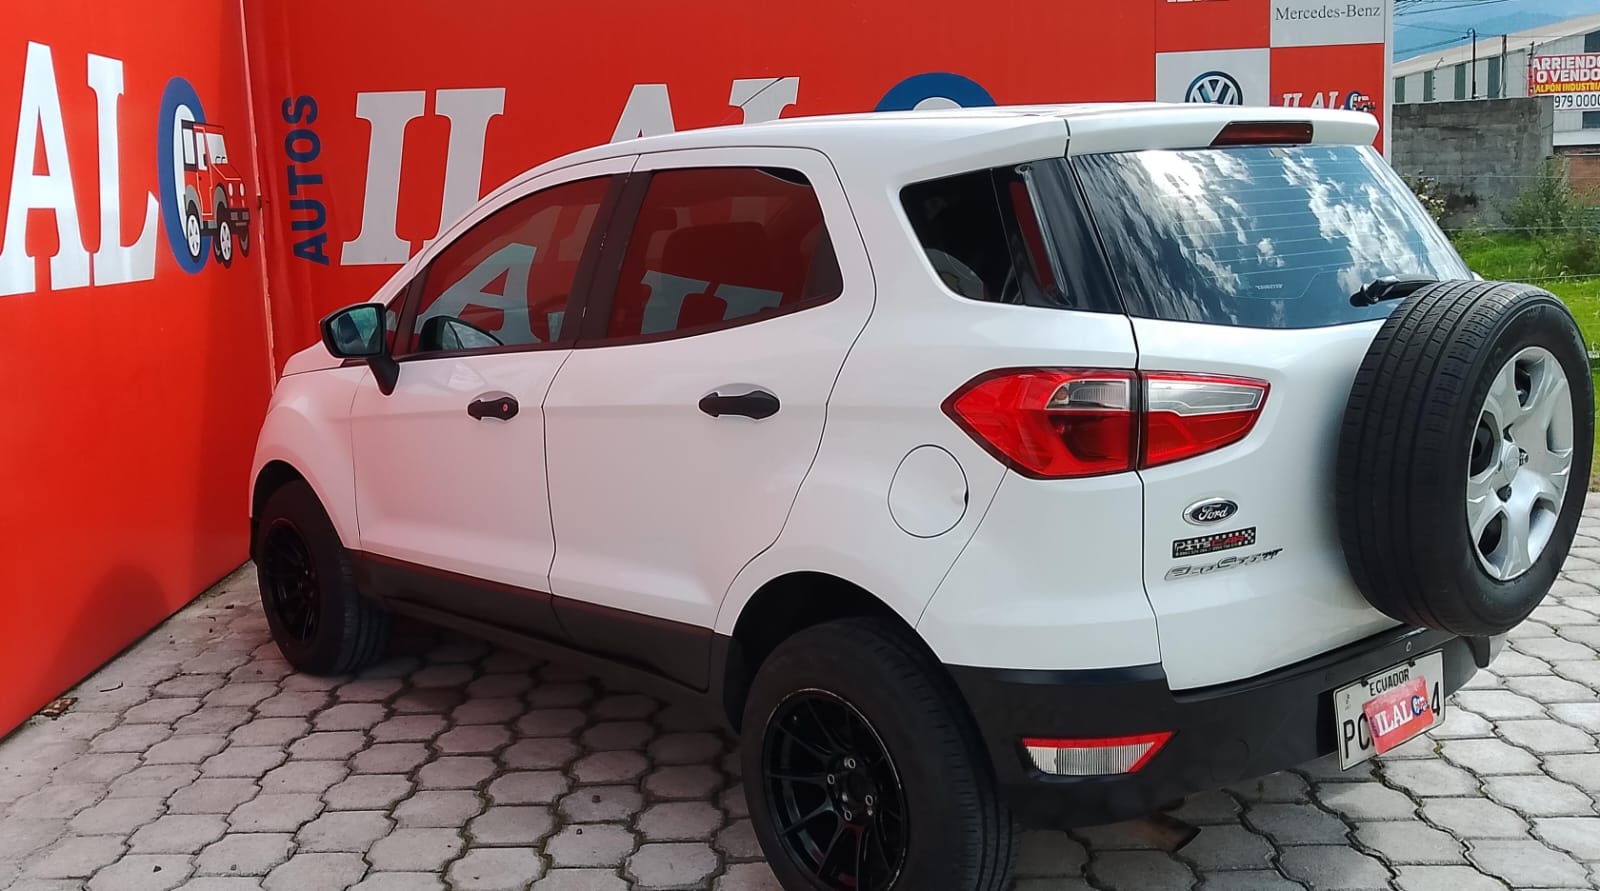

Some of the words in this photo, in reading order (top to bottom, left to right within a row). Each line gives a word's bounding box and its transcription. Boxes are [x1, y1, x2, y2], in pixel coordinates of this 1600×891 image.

[1276, 4, 1381, 20] Mercedes-Benz
[1536, 70, 1548, 83] O
[1549, 68, 1600, 83] VENDO
[281, 95, 330, 266] AUTOS
[1198, 502, 1229, 521] Ford
[1370, 668, 1410, 696] ECUADOR
